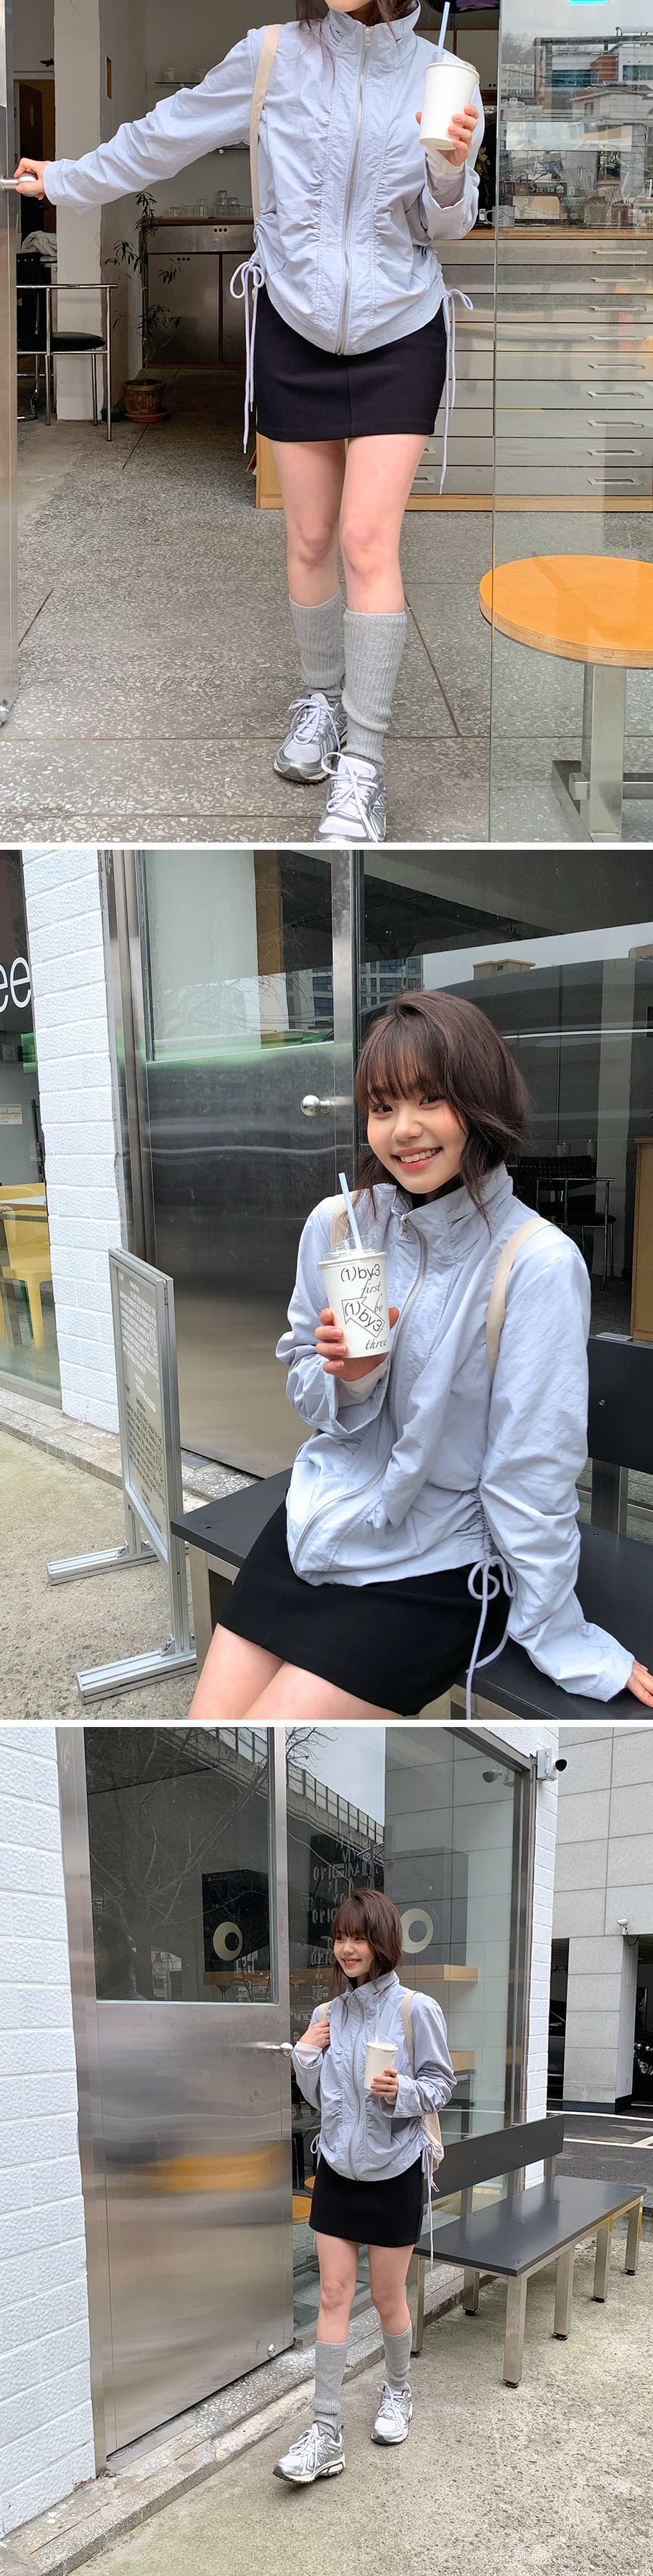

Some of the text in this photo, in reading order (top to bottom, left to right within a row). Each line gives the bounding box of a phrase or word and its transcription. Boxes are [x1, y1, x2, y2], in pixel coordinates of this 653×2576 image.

[340, 1264, 381, 1282] (1)by3
[361, 1281, 381, 1296] first
[345, 1301, 383, 1332] (1)by3
